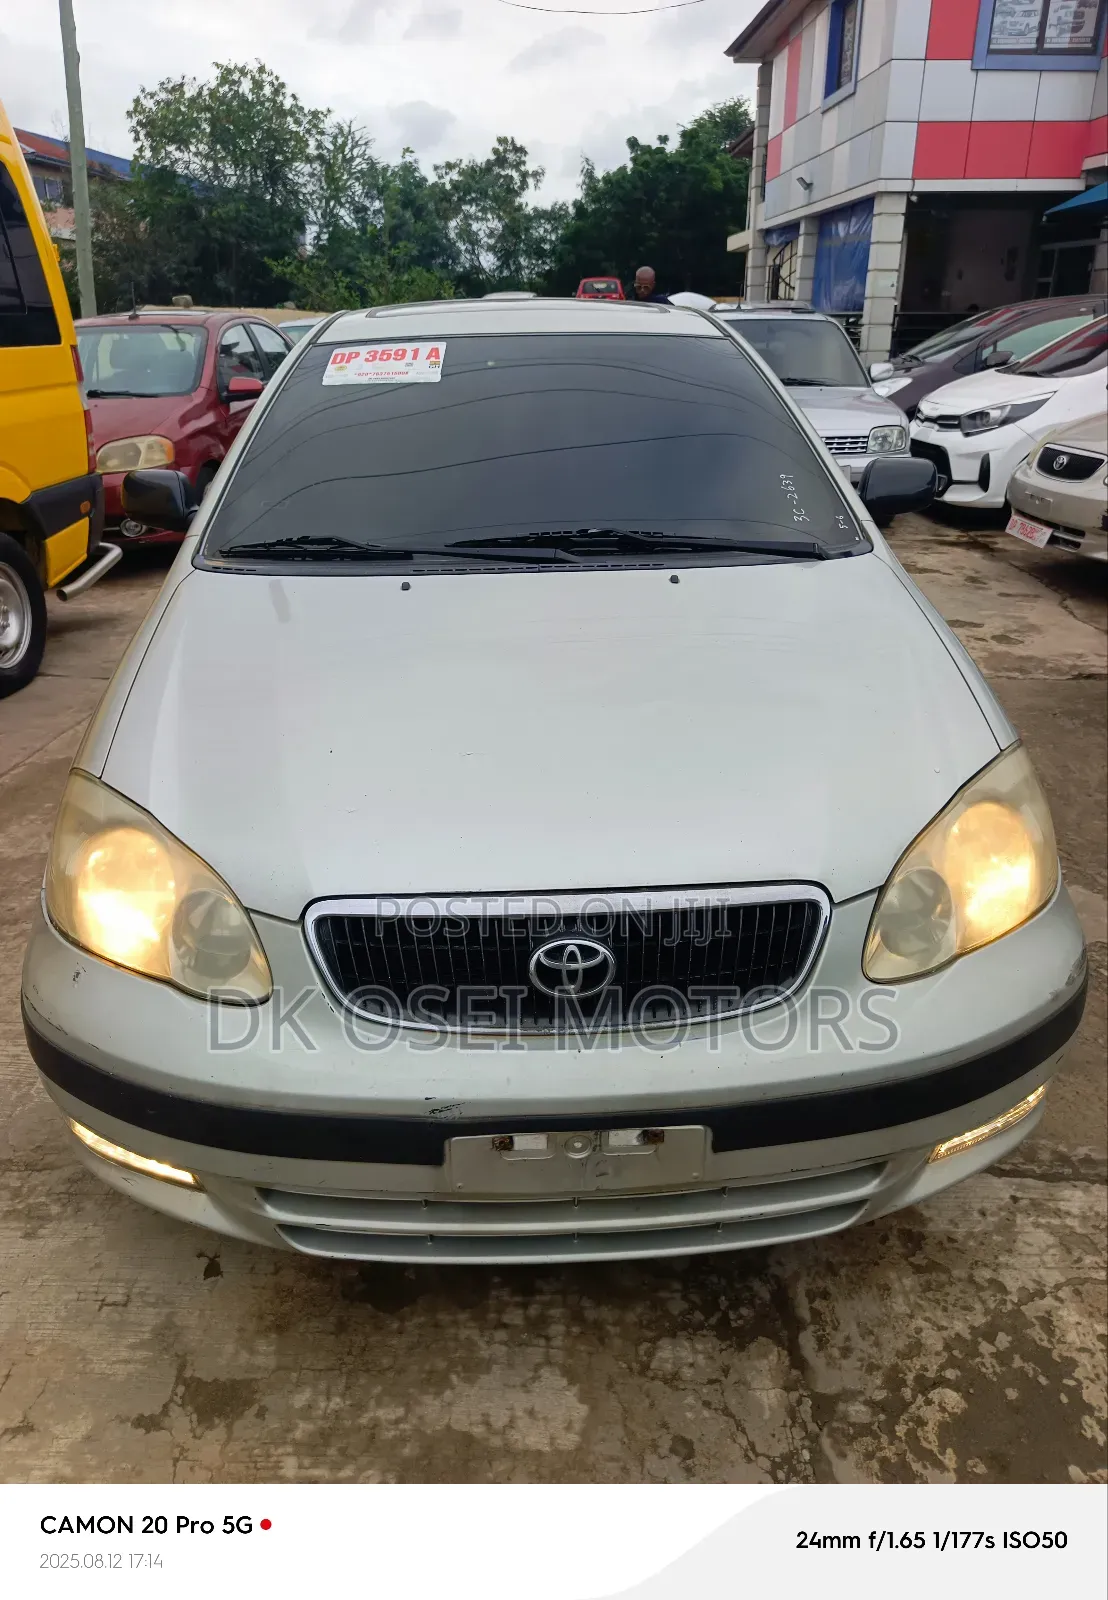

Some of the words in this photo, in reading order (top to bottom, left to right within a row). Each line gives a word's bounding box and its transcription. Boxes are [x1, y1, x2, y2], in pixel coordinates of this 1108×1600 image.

[331, 351, 361, 365] DP
[364, 347, 420, 362] 3591
[425, 347, 441, 360] A
